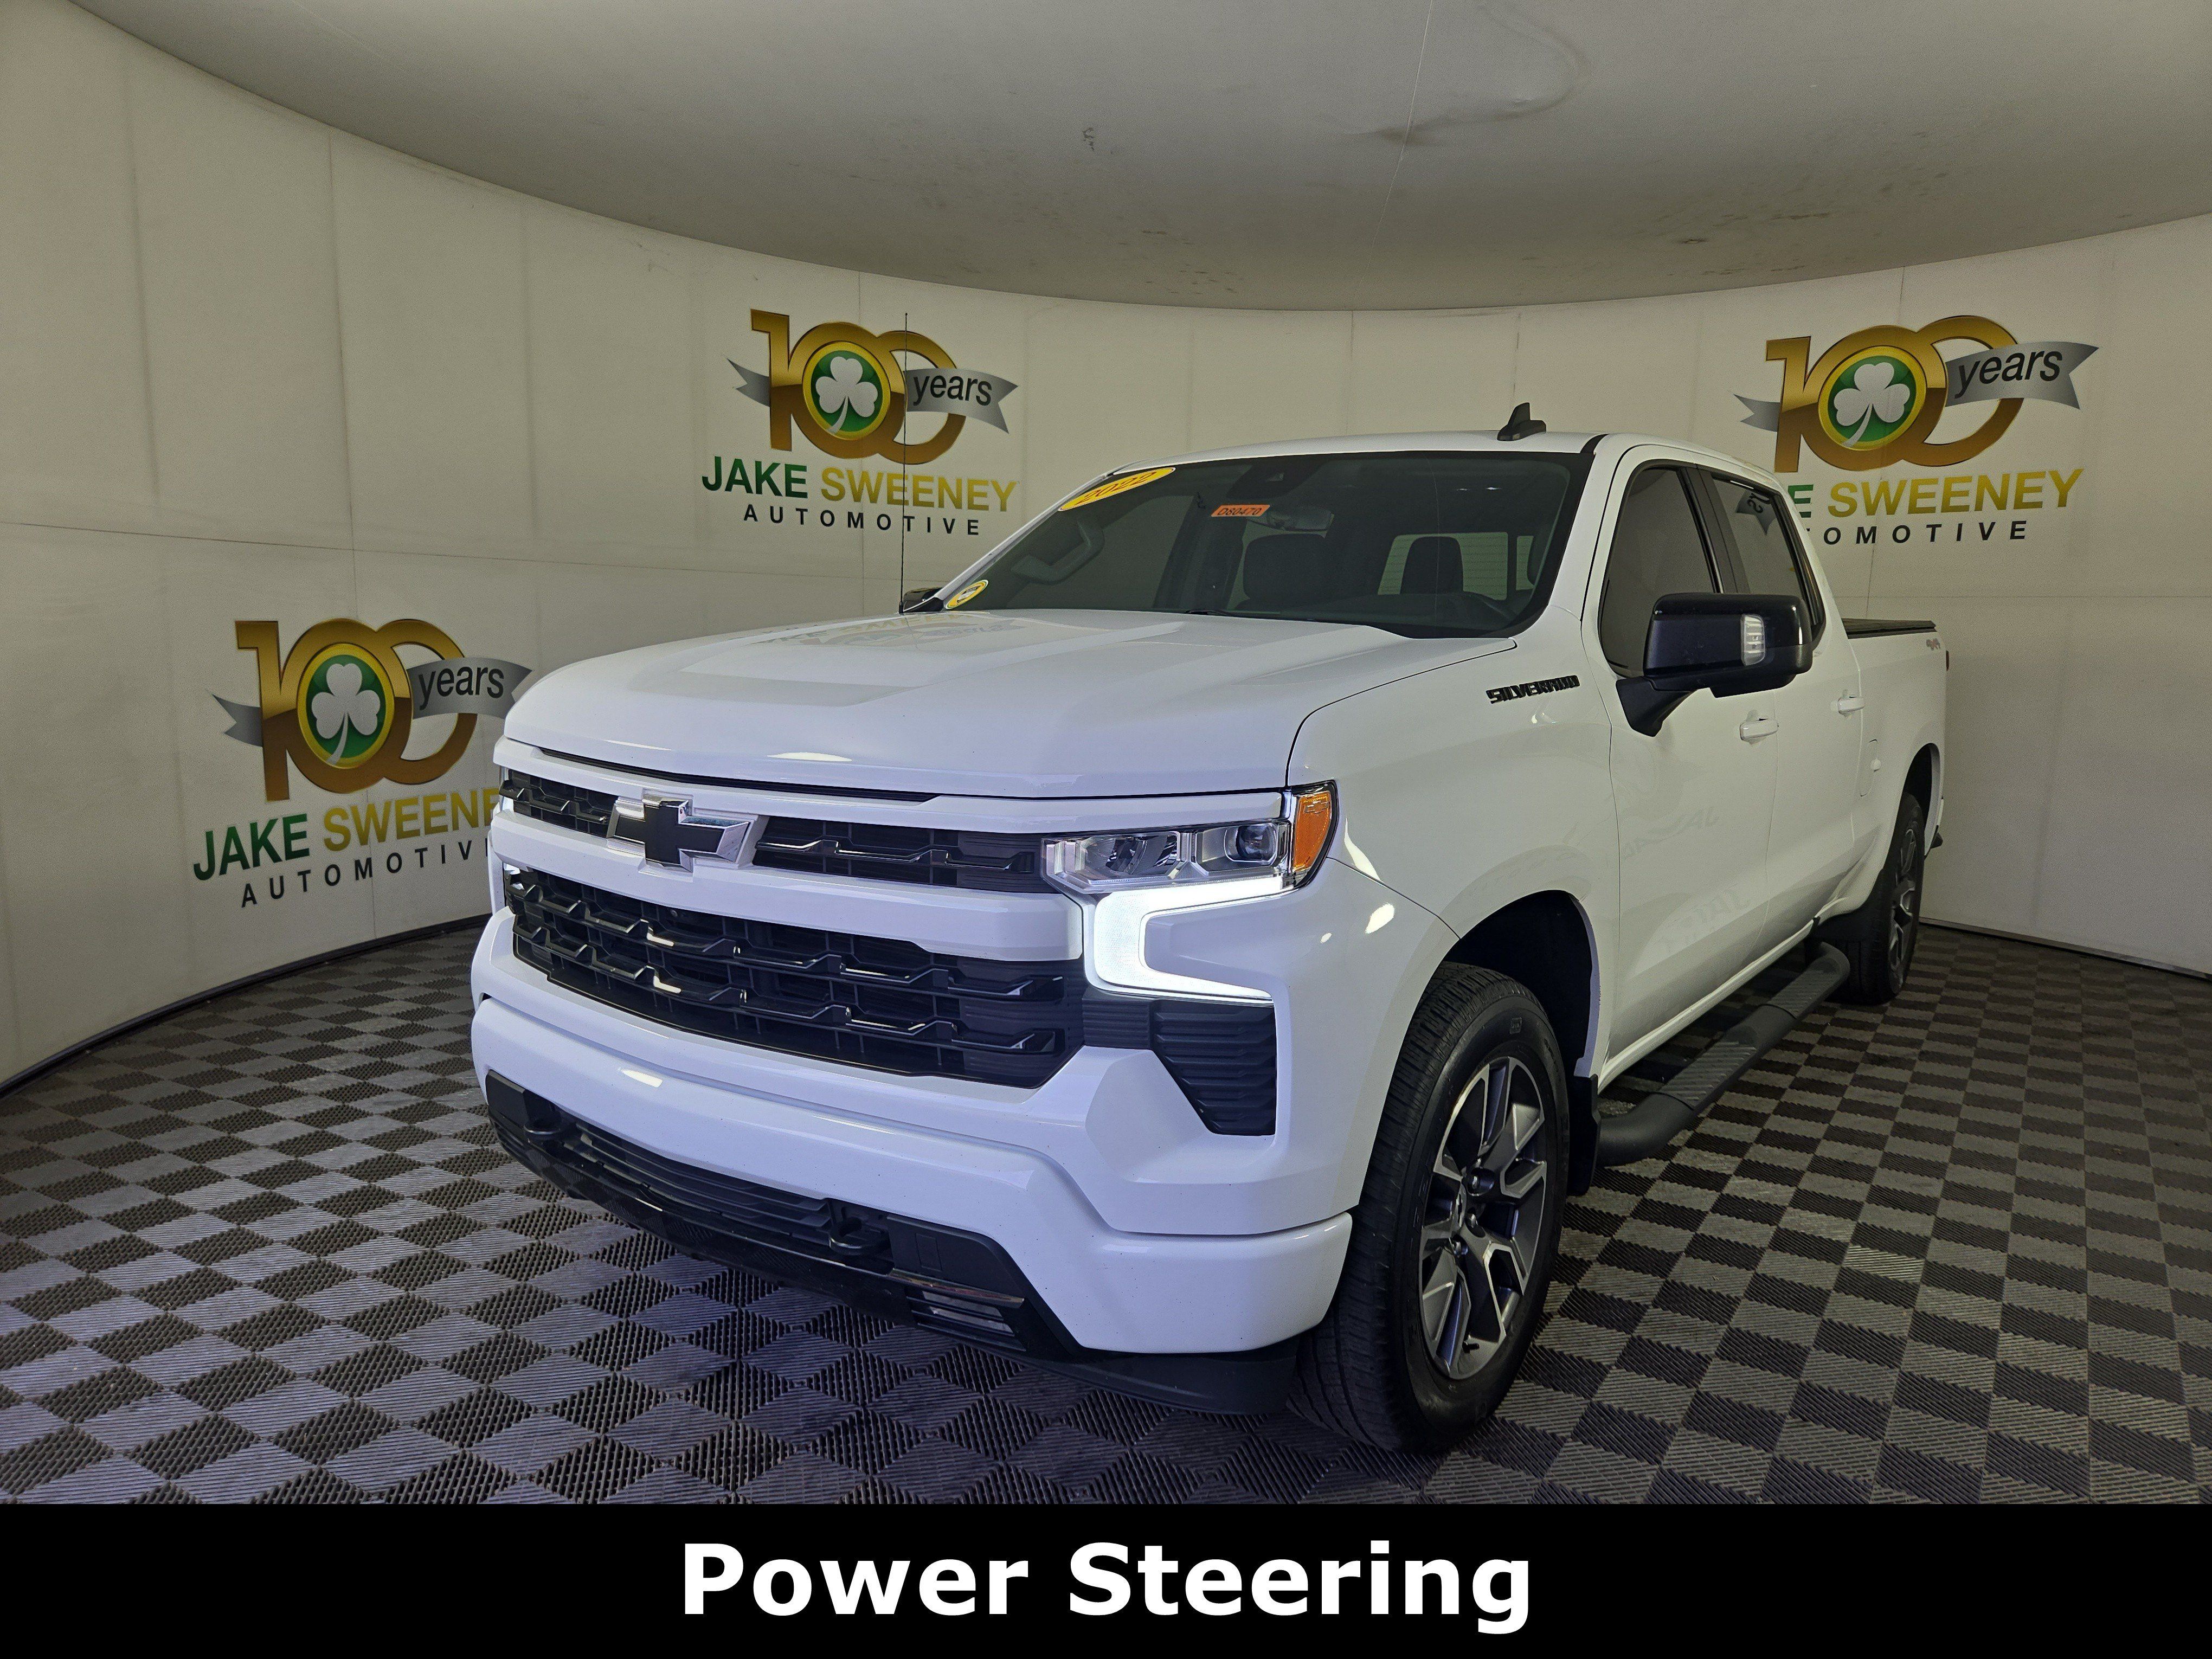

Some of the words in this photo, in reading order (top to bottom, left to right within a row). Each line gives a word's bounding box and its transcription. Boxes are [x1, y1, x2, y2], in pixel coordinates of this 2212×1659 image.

[751, 308, 966, 465] 100
[912, 372, 992, 406] years
[1765, 315, 2024, 472] 100
[1954, 348, 2063, 398] years
[702, 456, 808, 498] JAKE
[821, 467, 1017, 512] SWEENEY
[1074, 471, 1156, 505] 2022
[1828, 468, 2085, 518] SWEENEY
[744, 504, 979, 535] AUTOMOTIVE
[1824, 520, 2028, 545] OMOTIVE
[235, 618, 477, 801] 100
[419, 666, 504, 710] years
[1486, 675, 1580, 704] SILVERADO
[194, 813, 310, 880] JAKE
[324, 788, 499, 851] SWEENE
[242, 838, 487, 908] AUTOMOTIV
